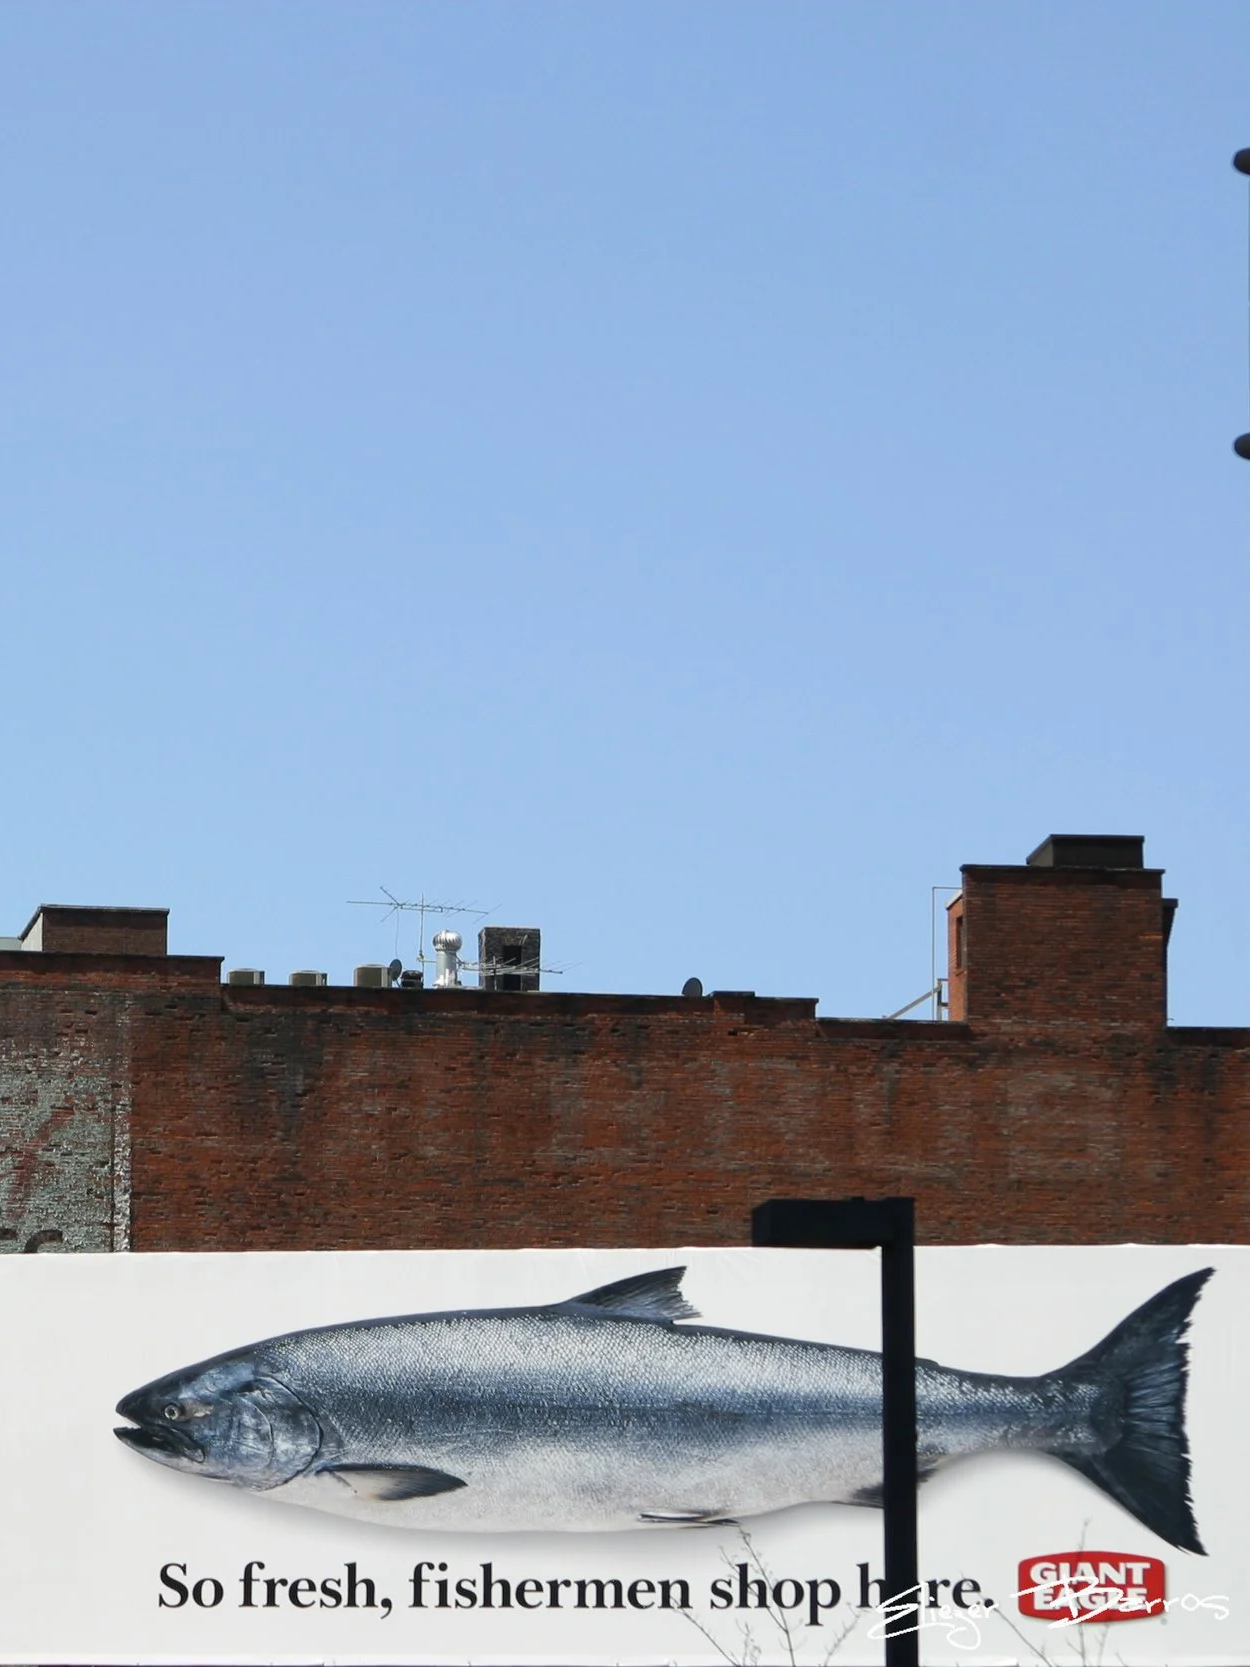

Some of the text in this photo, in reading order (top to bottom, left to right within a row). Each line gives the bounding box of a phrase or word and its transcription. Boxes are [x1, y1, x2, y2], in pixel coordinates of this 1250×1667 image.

[158, 1561, 994, 1626] So fresh, fishermen shop hre.
[1029, 1562, 1151, 1586] GIANT
